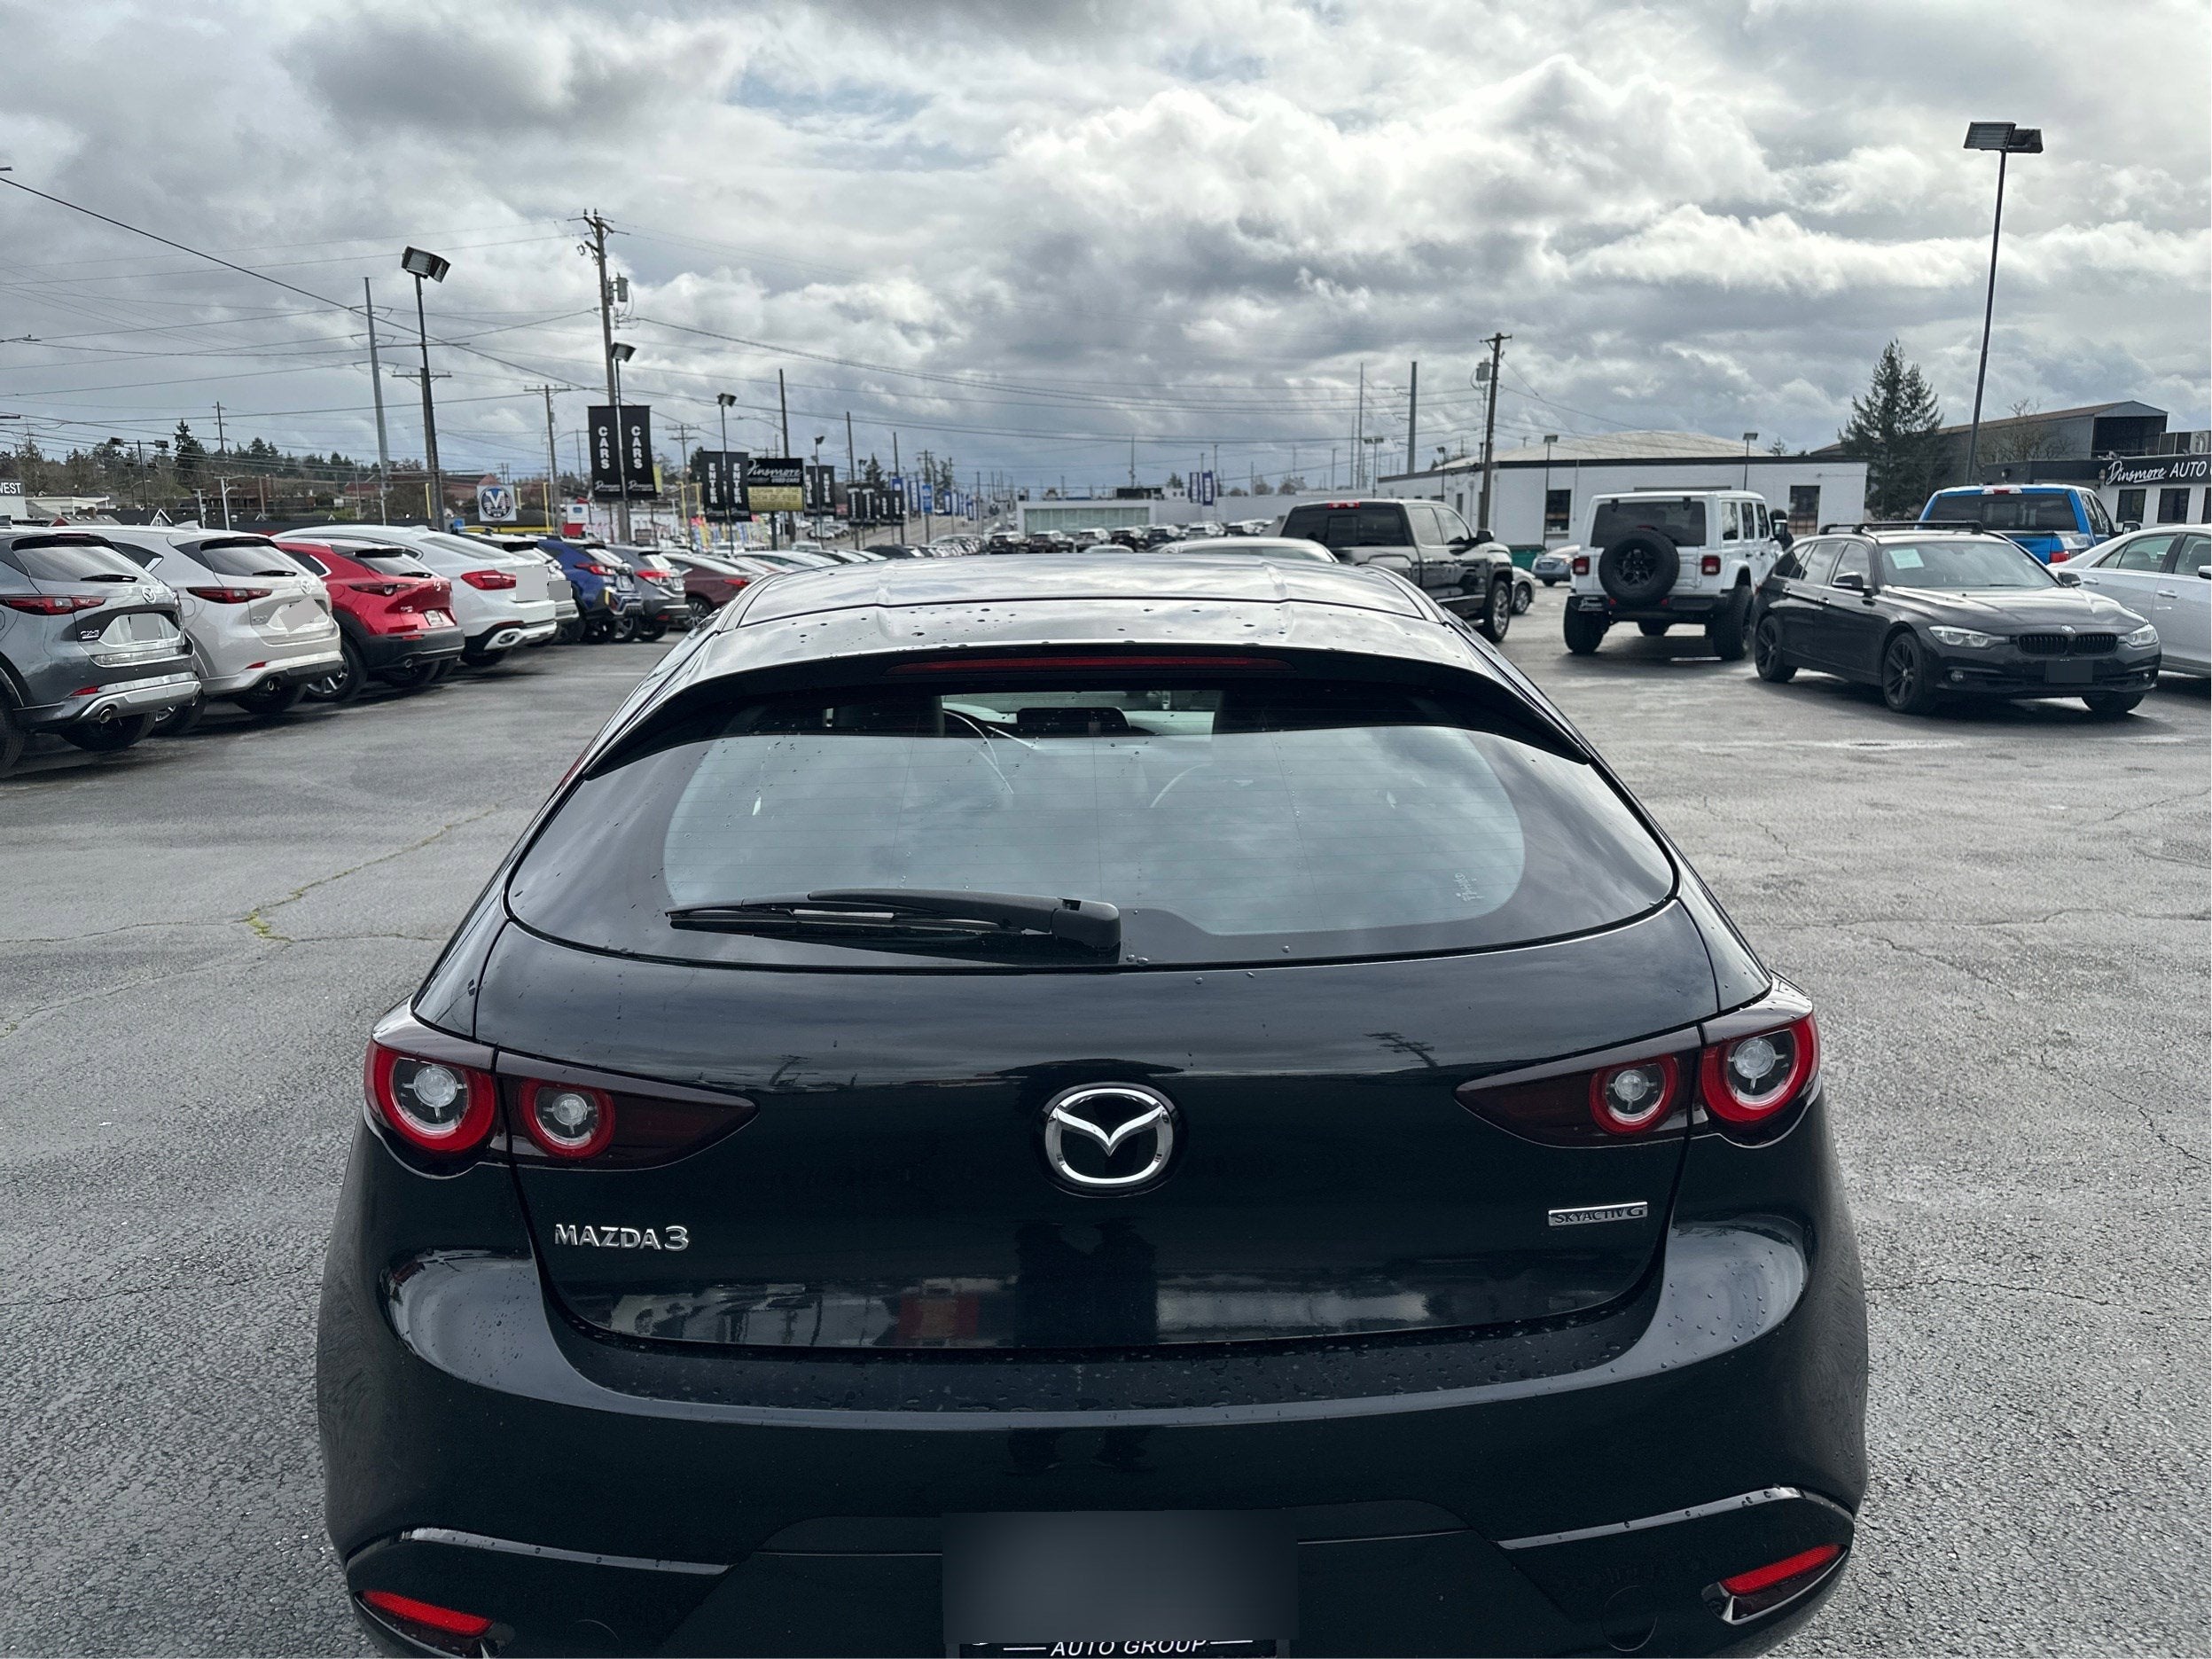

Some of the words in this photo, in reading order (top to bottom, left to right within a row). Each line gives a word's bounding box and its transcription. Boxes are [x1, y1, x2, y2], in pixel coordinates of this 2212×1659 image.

[598, 426, 610, 469] CARS
[630, 426, 643, 469] CARS
[708, 463, 718, 504] ENTER
[733, 463, 742, 504] ENTER
[2106, 460, 2168, 485] Dinsmore
[2169, 461, 2207, 478] AUTO
[1051, 1641, 1114, 1656] AUTO
[1123, 1640, 1207, 1655] GROUP
